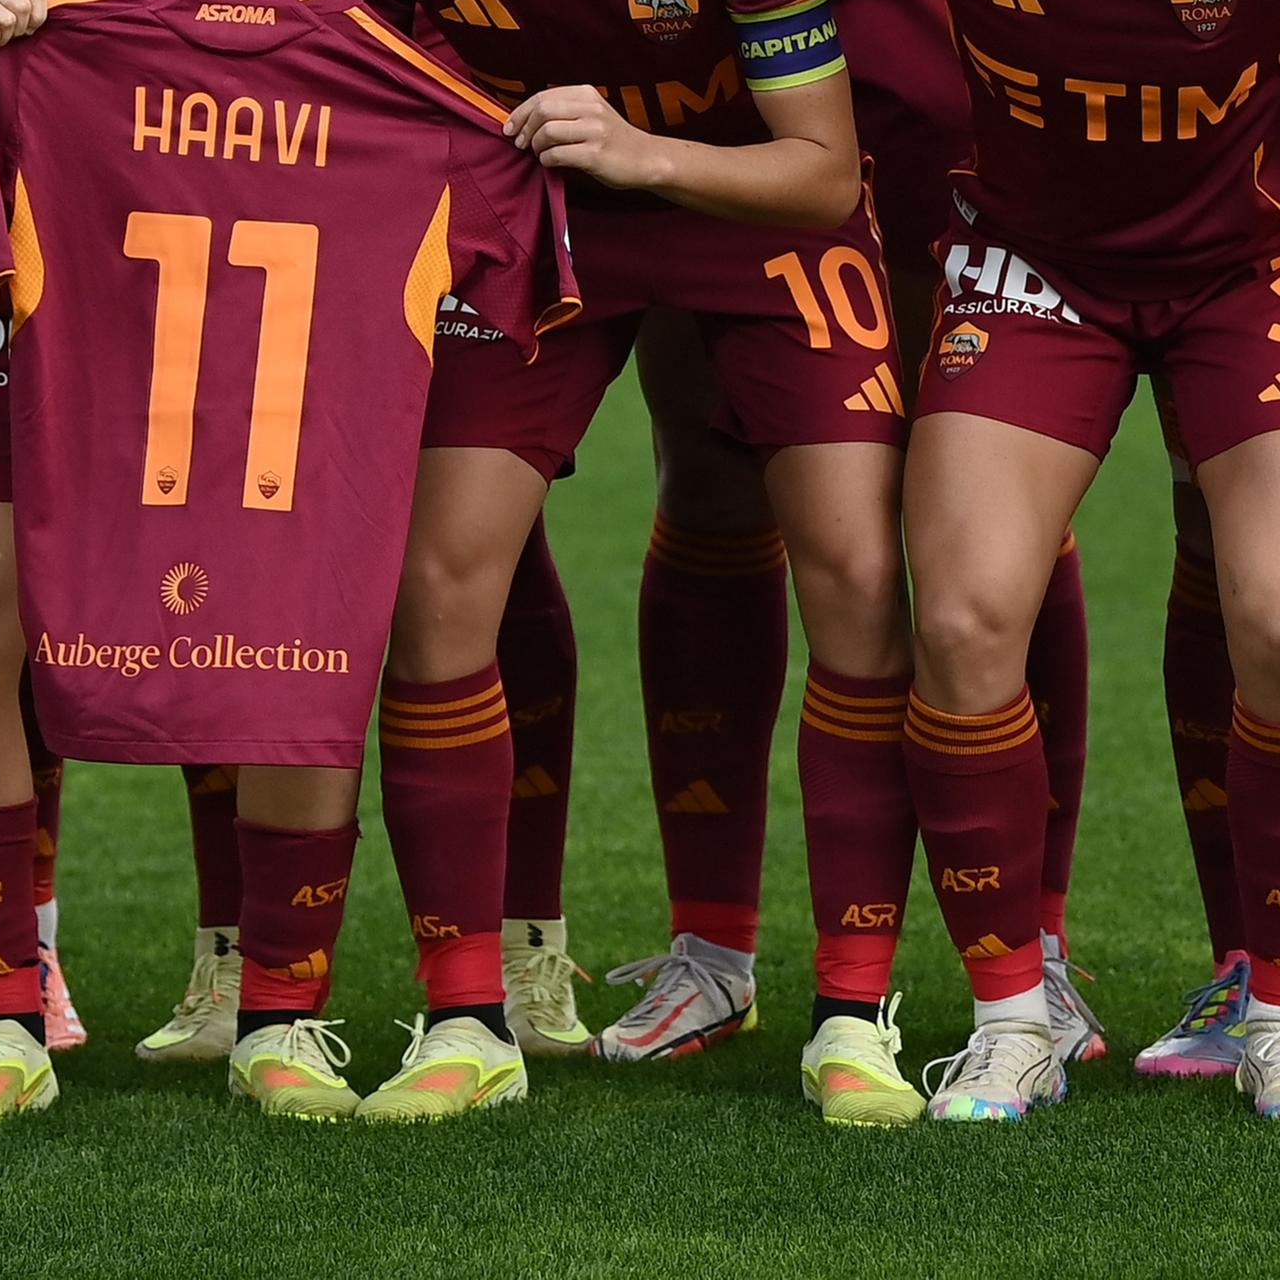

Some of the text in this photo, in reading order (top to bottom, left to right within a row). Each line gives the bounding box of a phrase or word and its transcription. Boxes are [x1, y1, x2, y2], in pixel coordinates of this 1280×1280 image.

[642, 19, 692, 35] ROMA
[1181, 6, 1233, 22] ROMA
[1196, 22, 1217, 33] 1927
[1064, 62, 1258, 142] TIM
[132, 86, 331, 167] HAAVI
[764, 246, 890, 351] 10
[434, 321, 504, 341] CURAZI
[123, 211, 320, 512] 11
[939, 354, 974, 367] ROMA
[33, 631, 350, 678] Auberge Collection
[290, 875, 349, 908] ASR
[940, 865, 1001, 893] ASR
[841, 901, 898, 929] ASR
